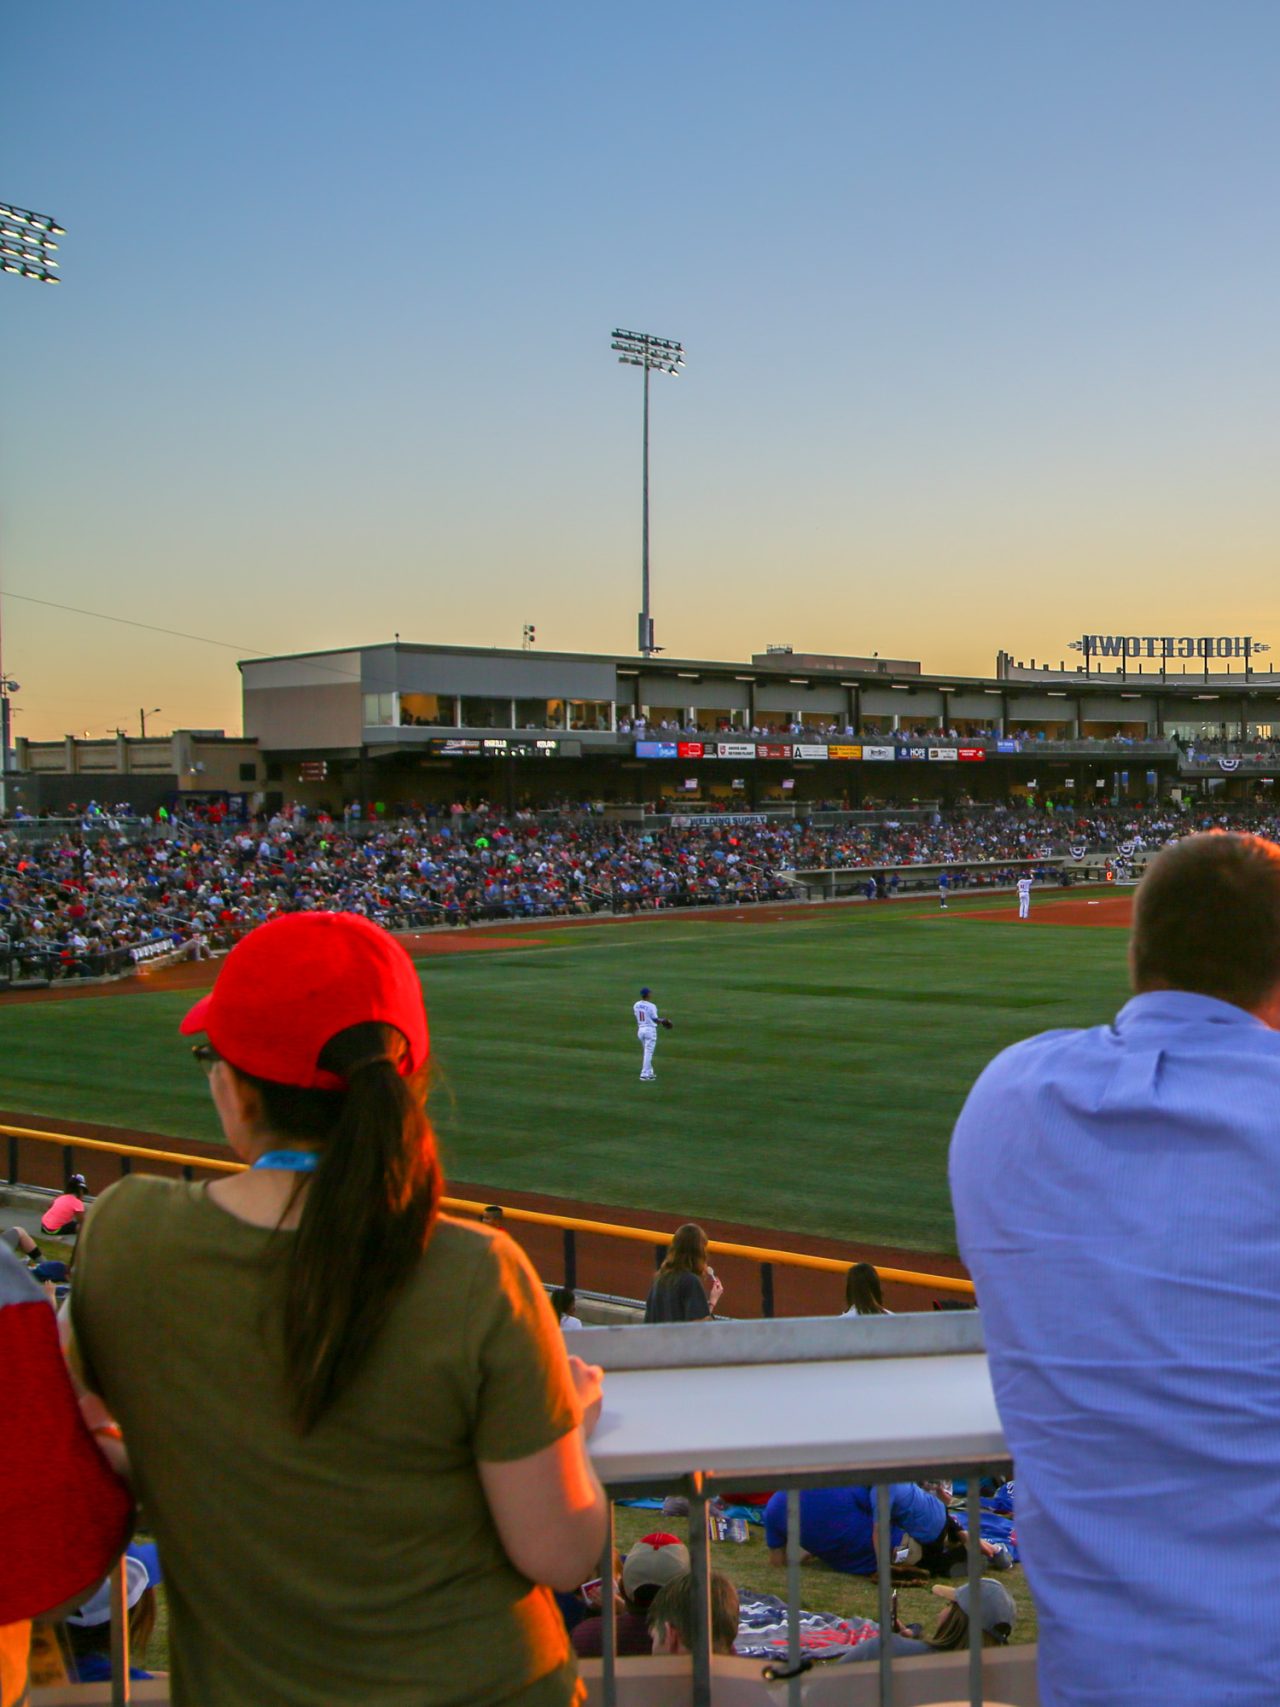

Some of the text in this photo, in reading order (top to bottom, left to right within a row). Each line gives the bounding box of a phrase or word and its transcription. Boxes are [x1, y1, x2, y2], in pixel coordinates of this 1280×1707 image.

[910, 748, 926, 756] HOPE
[691, 816, 765, 825] WELDING SUPPLY
